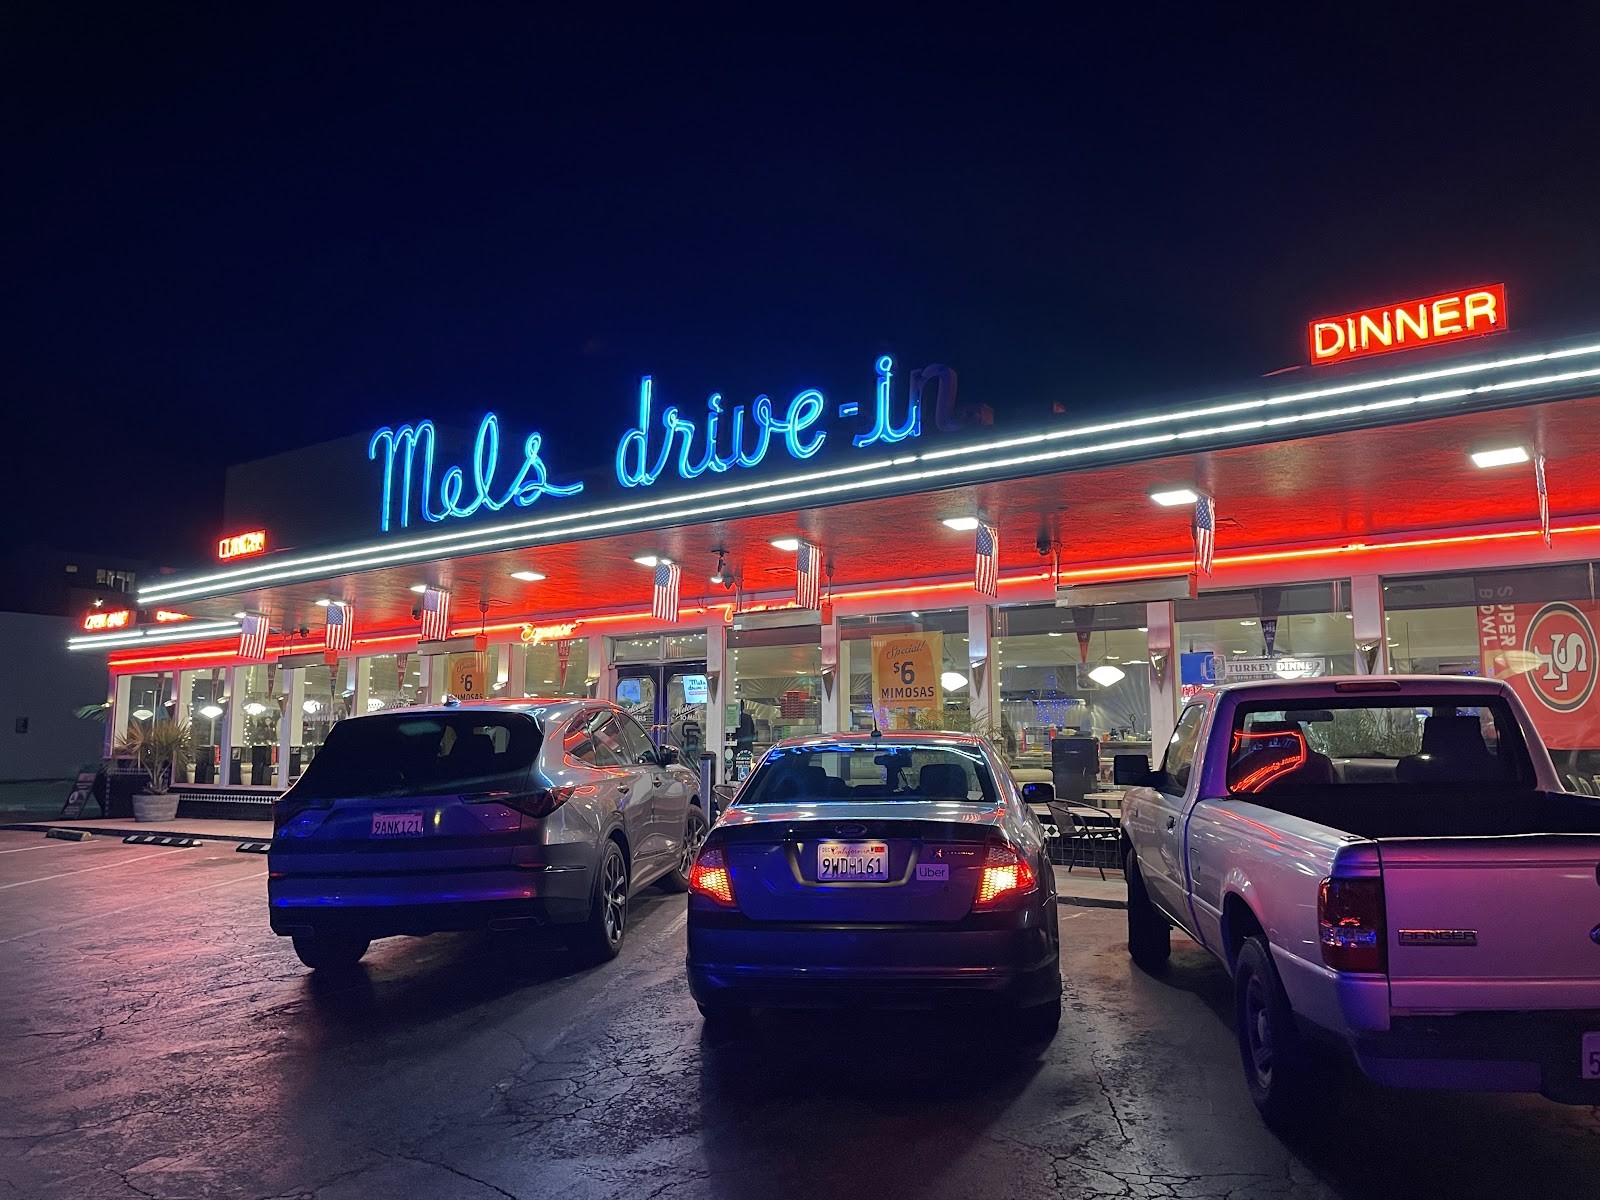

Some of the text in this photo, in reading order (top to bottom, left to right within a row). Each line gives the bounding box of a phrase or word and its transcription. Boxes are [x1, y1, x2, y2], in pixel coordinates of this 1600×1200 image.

[1314, 291, 1498, 359] DINNER
[369, 411, 584, 532] Mels
[885, 640, 926, 660] Special!
[893, 661, 915, 685] $6
[1227, 662, 1272, 673] TURKEY
[459, 674, 473, 692] $6
[881, 686, 935, 699] MIMOSAS
[374, 820, 420, 835] 9ANK121
[832, 845, 870, 857] California
[821, 857, 884, 876] 9WDH161
[919, 867, 946, 878] Uber
[1401, 930, 1476, 940] RANGER
